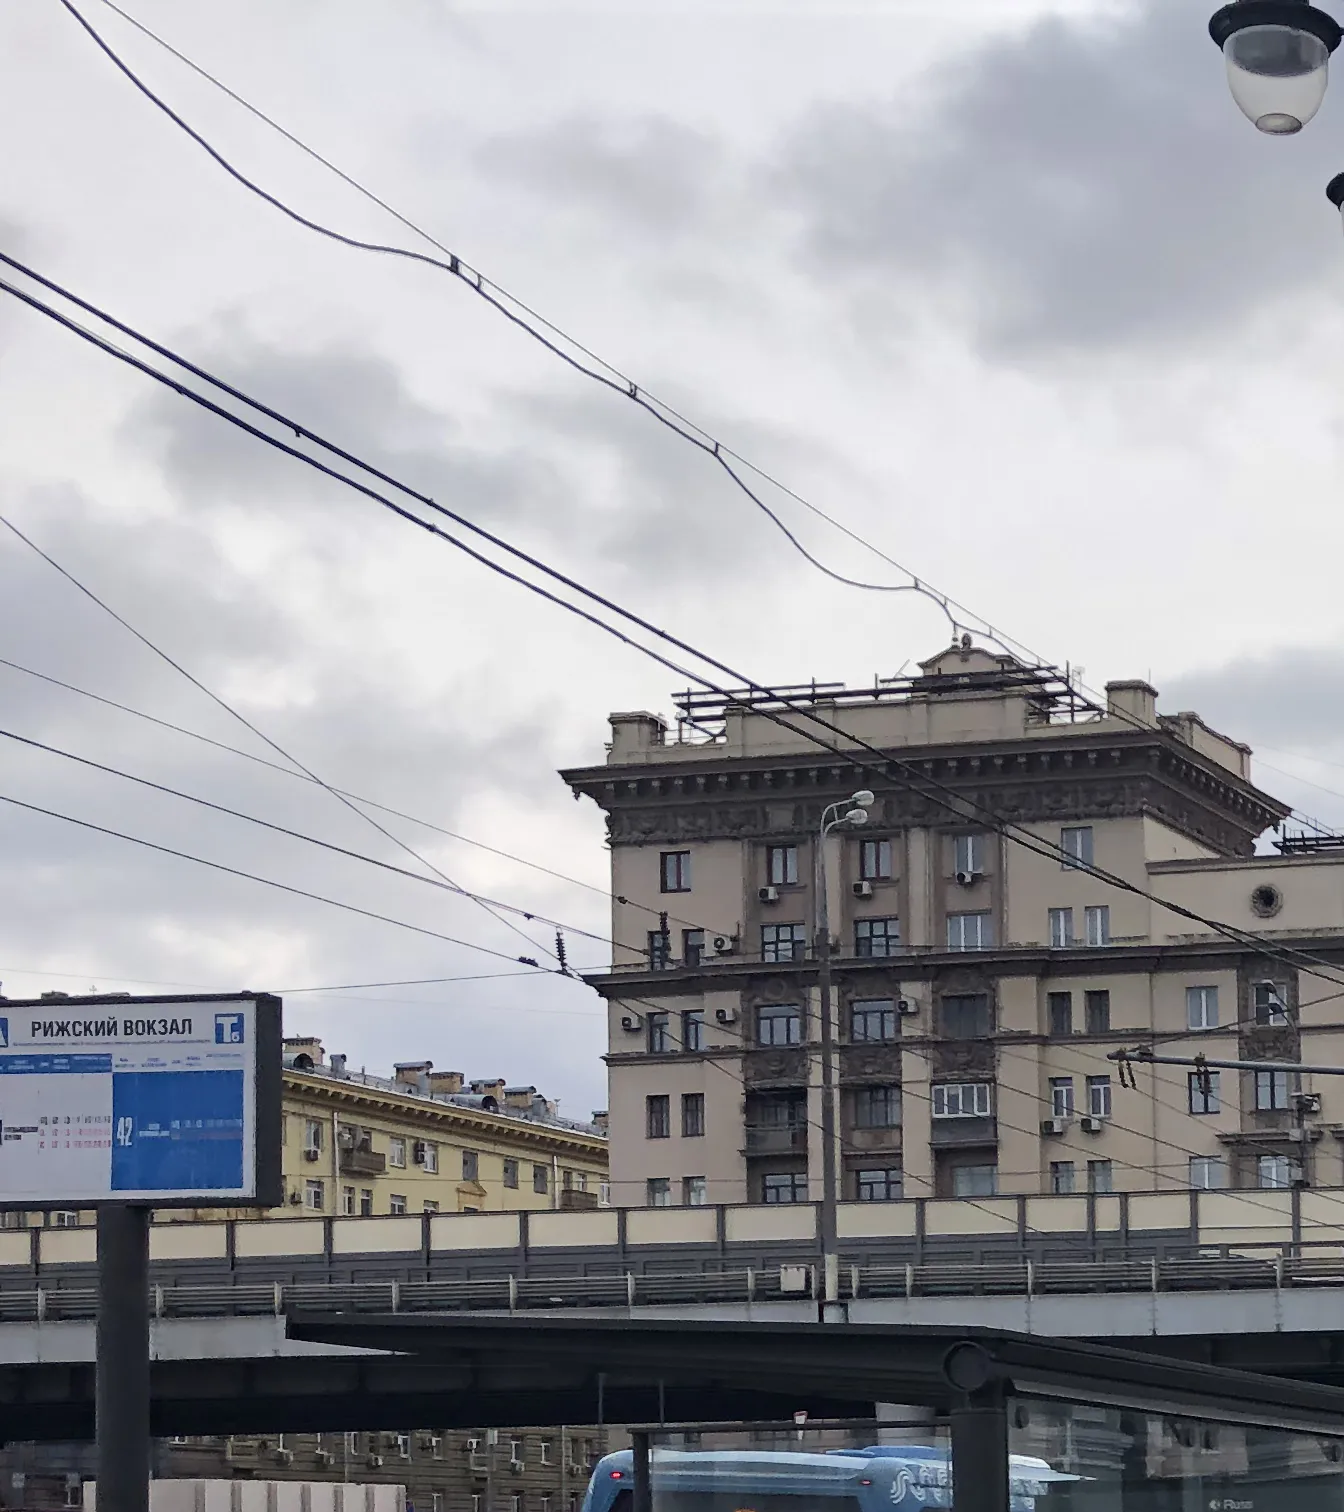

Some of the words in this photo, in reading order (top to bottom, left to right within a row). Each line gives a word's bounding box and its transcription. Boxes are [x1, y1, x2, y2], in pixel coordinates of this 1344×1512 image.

[31, 1016, 118, 1037] РИЖСКИЙ
[123, 1018, 192, 1036] ВОКЗАЛ
[117, 1116, 133, 1146] 42
